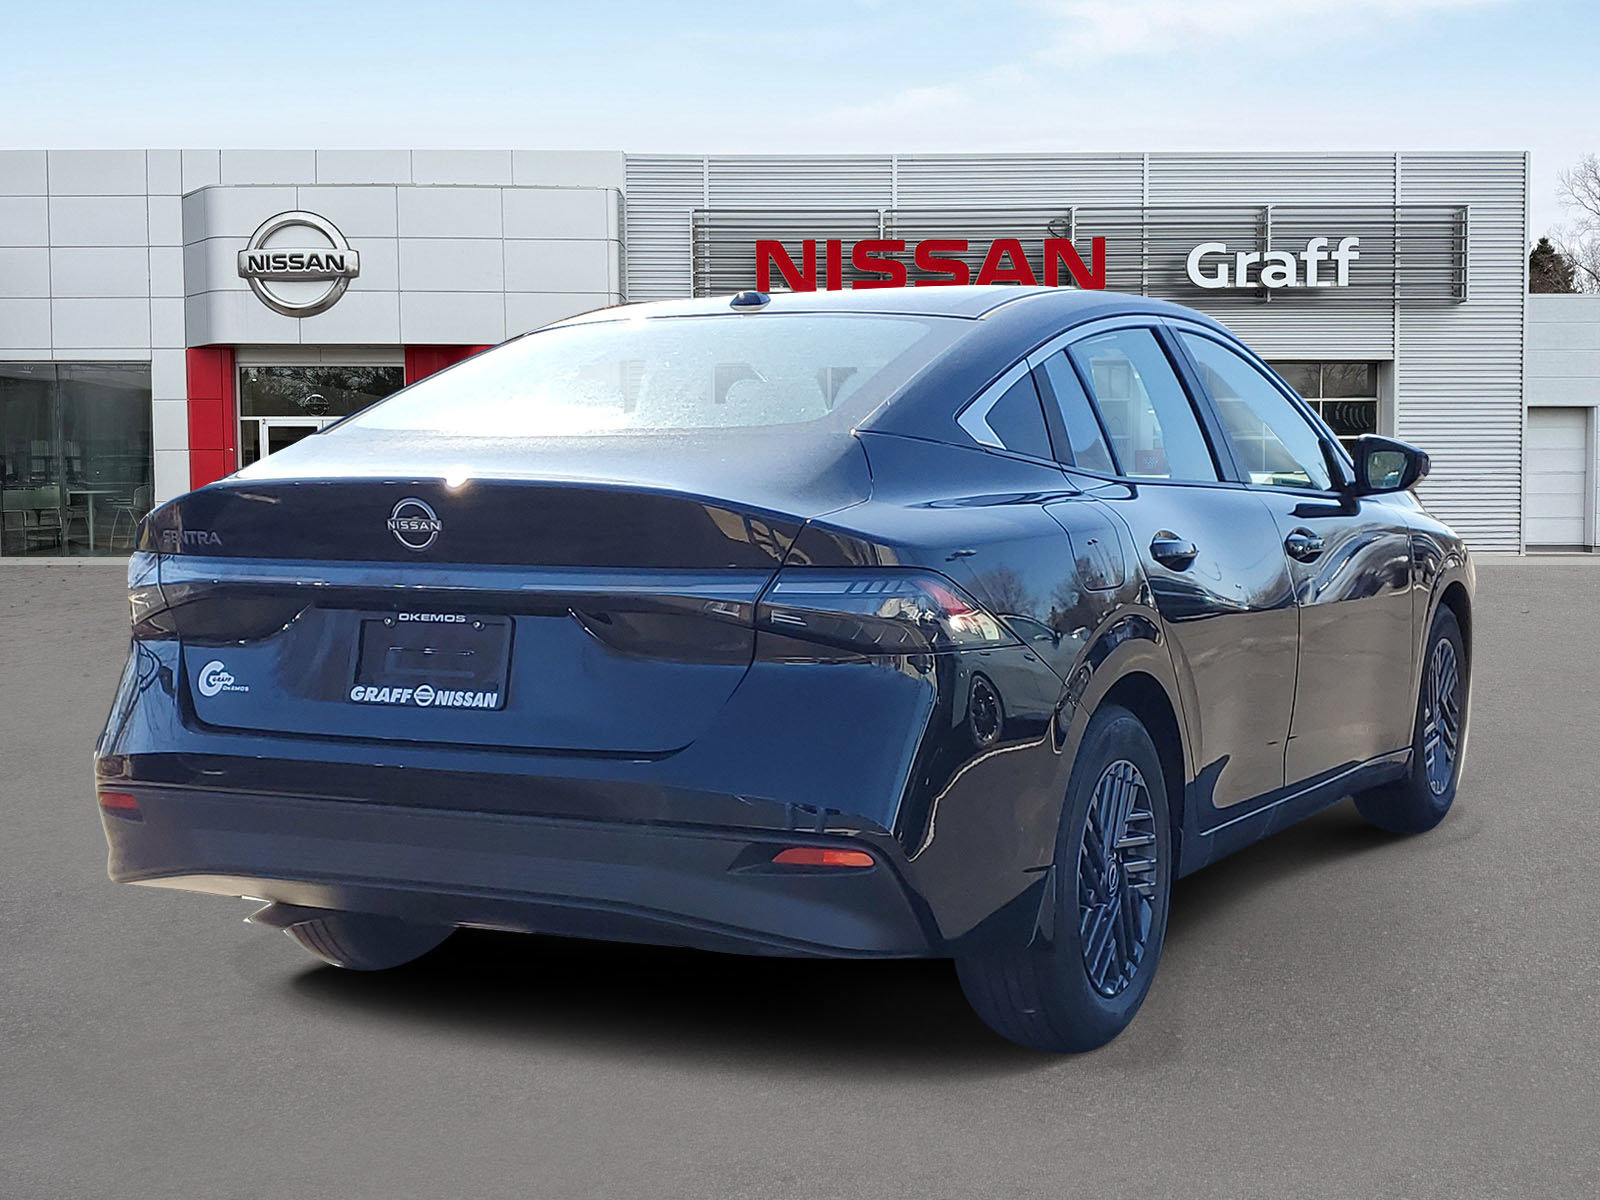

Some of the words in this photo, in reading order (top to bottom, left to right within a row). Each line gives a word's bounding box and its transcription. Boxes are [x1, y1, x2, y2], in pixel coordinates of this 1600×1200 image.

[247, 253, 345, 272] NISSAN
[755, 236, 1106, 292] NISSAN
[1186, 237, 1361, 289] Graff
[387, 519, 442, 531] NISSAN
[398, 612, 467, 623] OKEMOS
[350, 685, 413, 703] GRAFF
[435, 690, 499, 708] NISSAN
